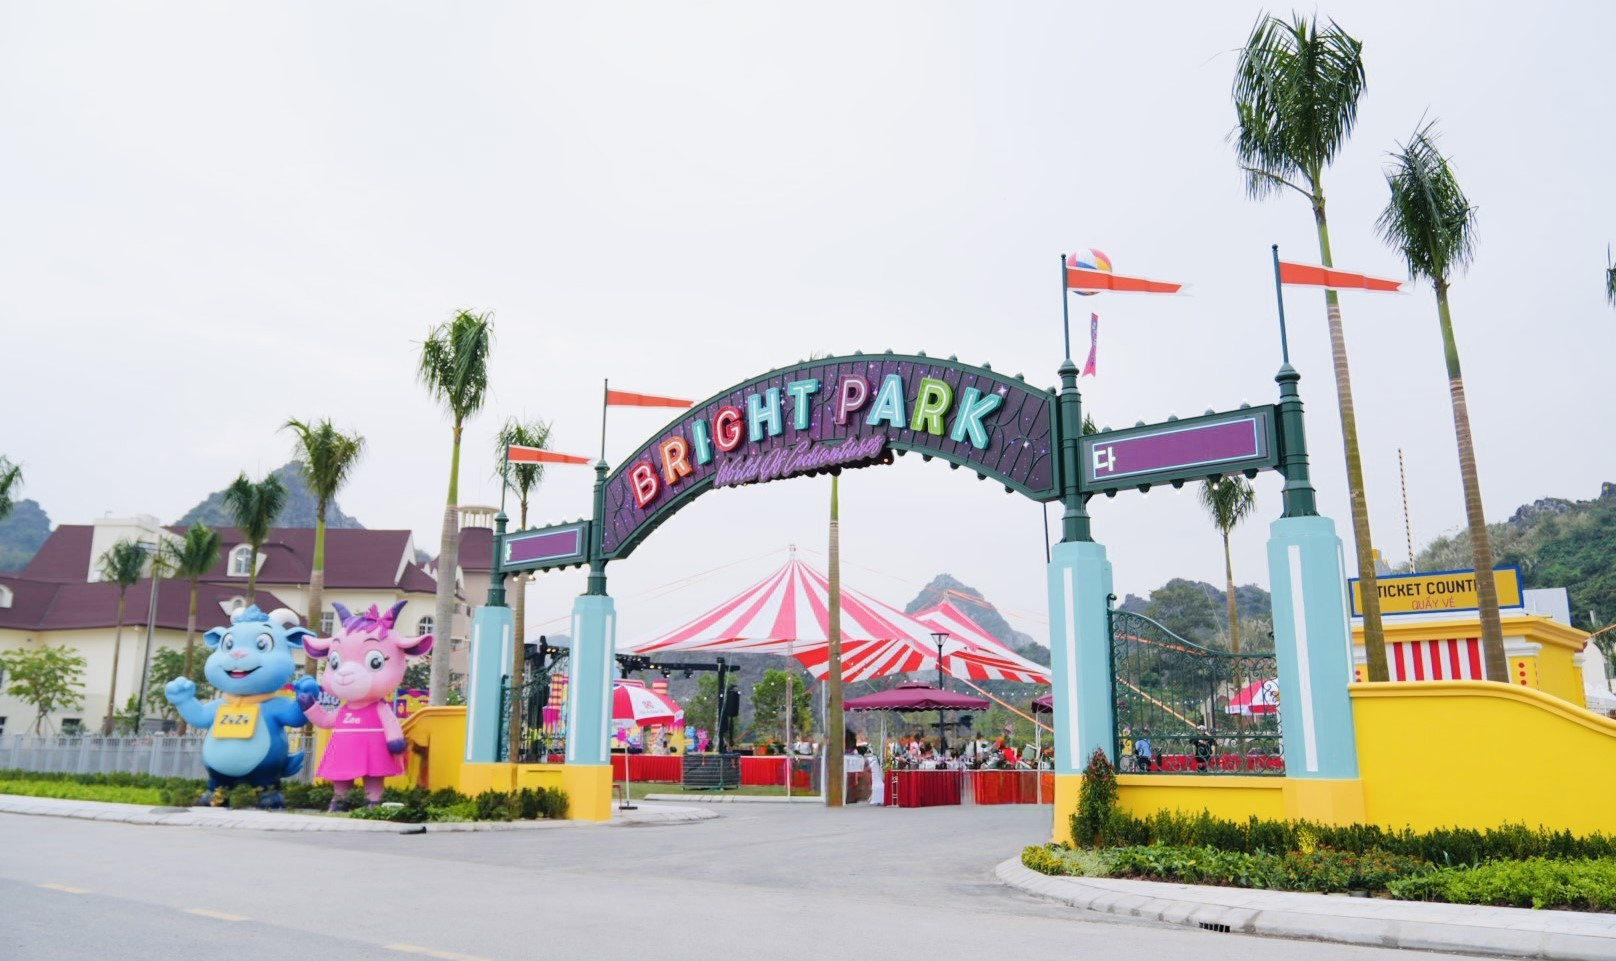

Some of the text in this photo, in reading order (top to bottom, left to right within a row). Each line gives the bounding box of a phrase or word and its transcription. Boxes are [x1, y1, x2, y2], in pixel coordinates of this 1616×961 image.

[628, 373, 1003, 509] BRIGHT PARK
[714, 455, 763, 487] World
[760, 447, 788, 480] Of
[1376, 583, 1422, 599] TICKET
